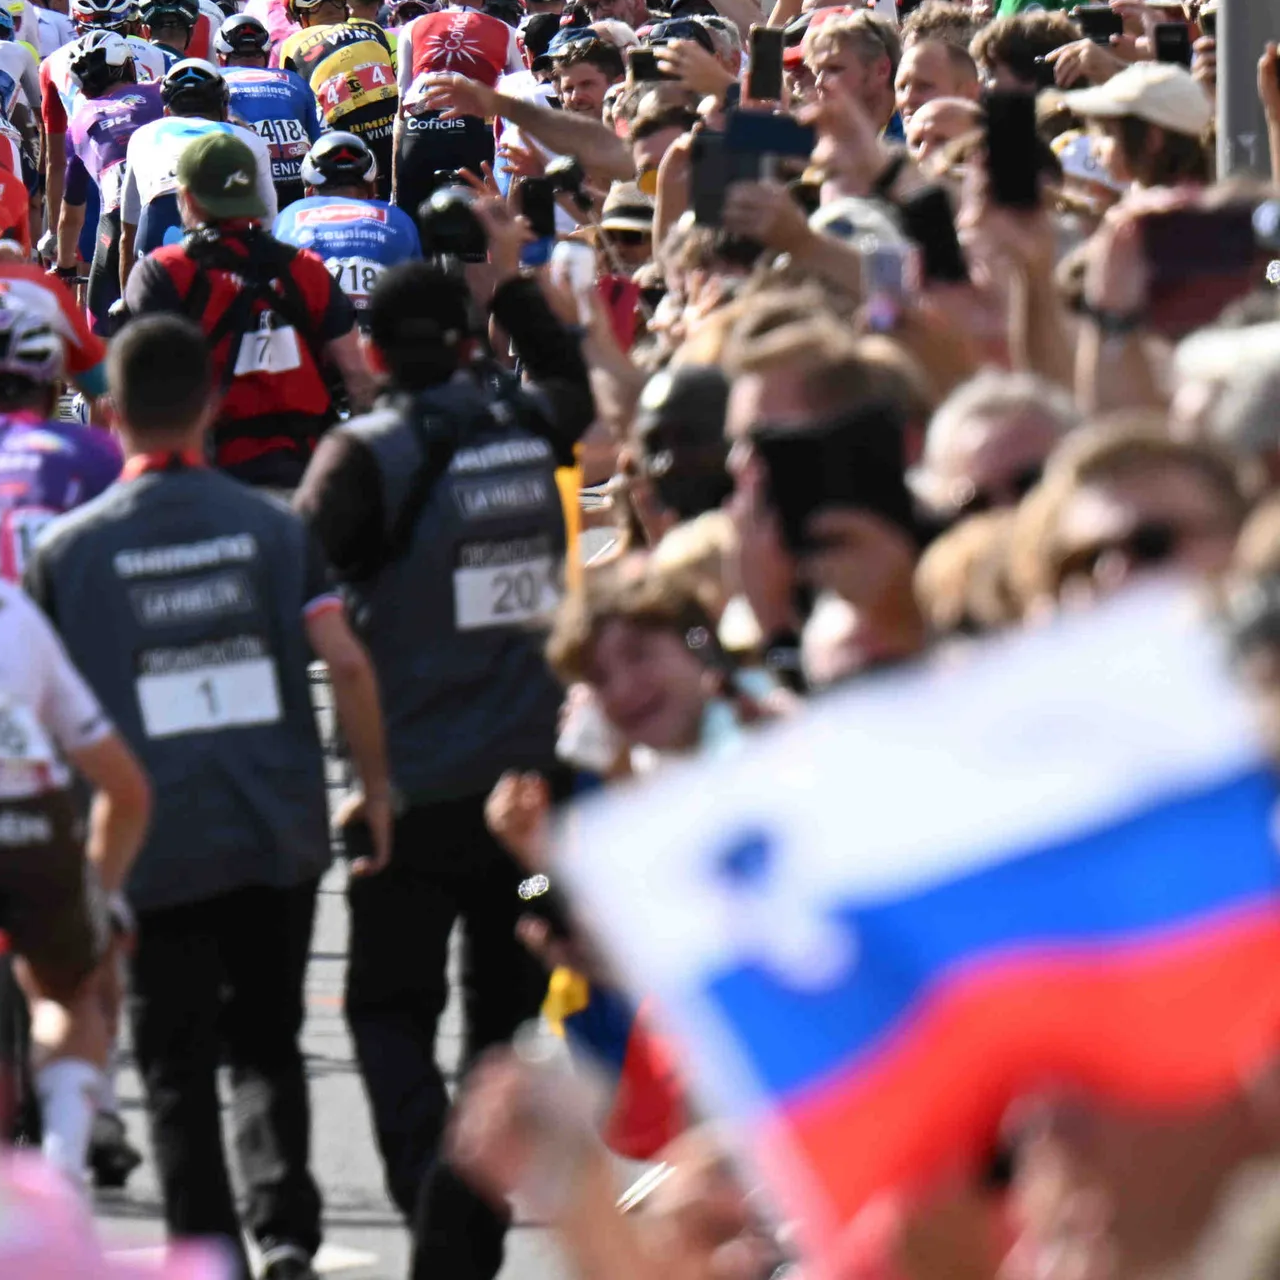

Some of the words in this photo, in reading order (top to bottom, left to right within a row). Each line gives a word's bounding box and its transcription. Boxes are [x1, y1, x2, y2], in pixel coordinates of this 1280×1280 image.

[326, 28, 379, 46] VISMA
[371, 66, 387, 85] 4
[327, 85, 340, 105] 4
[407, 117, 466, 130] Cofidis
[255, 336, 271, 363] 7
[492, 570, 536, 614] 20
[197, 675, 219, 716] 1
